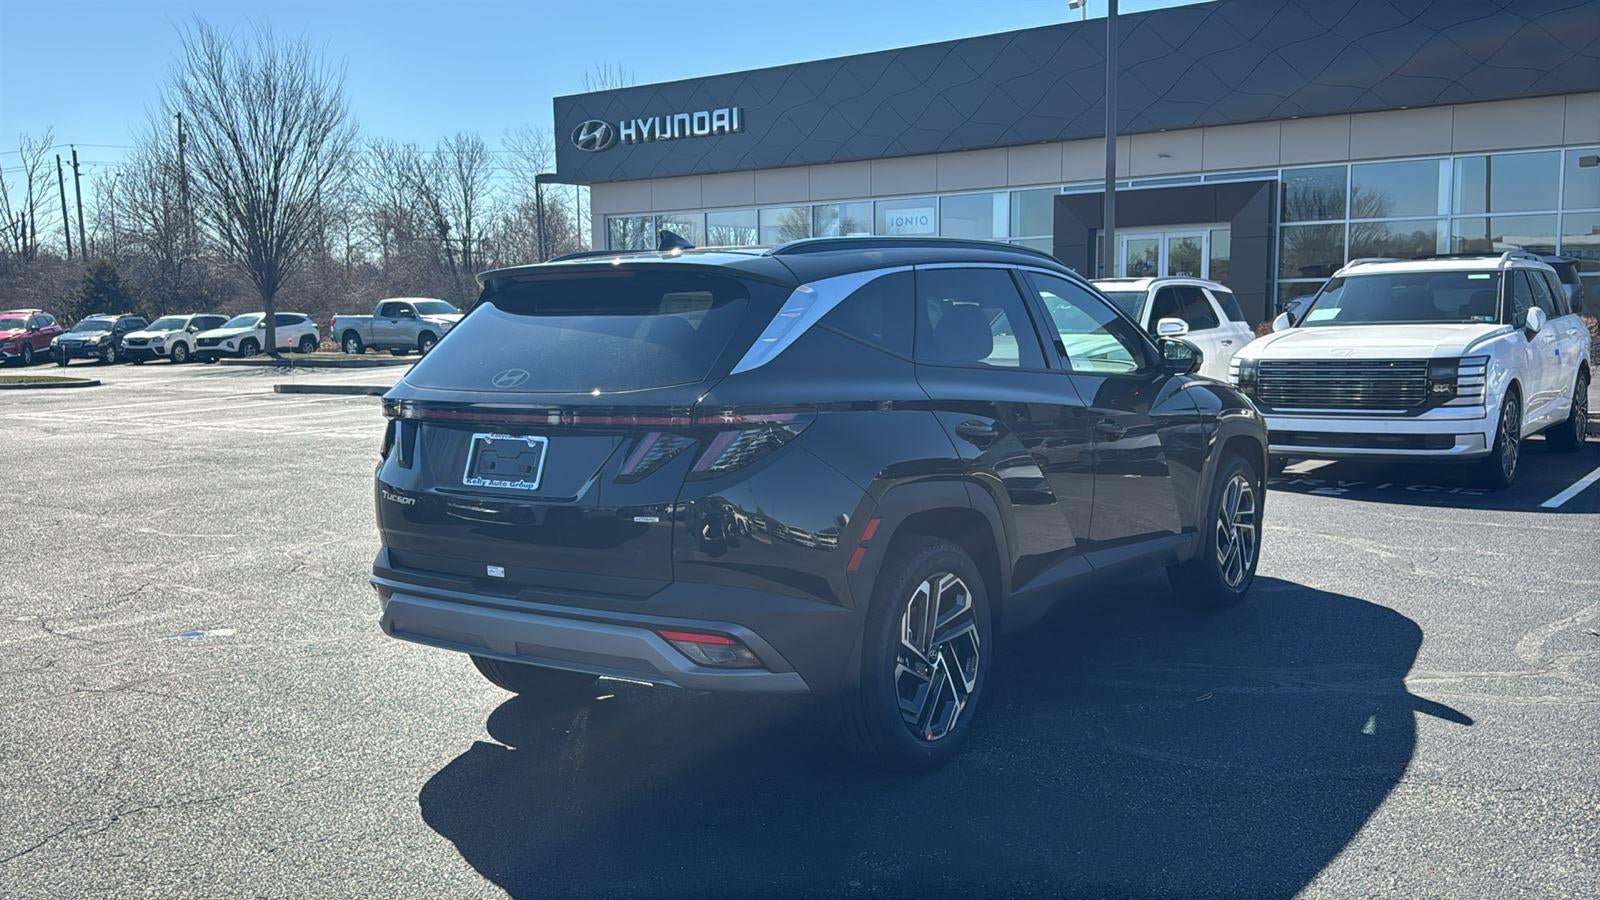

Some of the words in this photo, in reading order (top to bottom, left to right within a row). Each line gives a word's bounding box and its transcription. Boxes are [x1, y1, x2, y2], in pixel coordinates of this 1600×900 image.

[619, 107, 742, 143] HYUNDAI
[489, 479, 508, 488] Auto
[509, 481, 535, 491] Group
